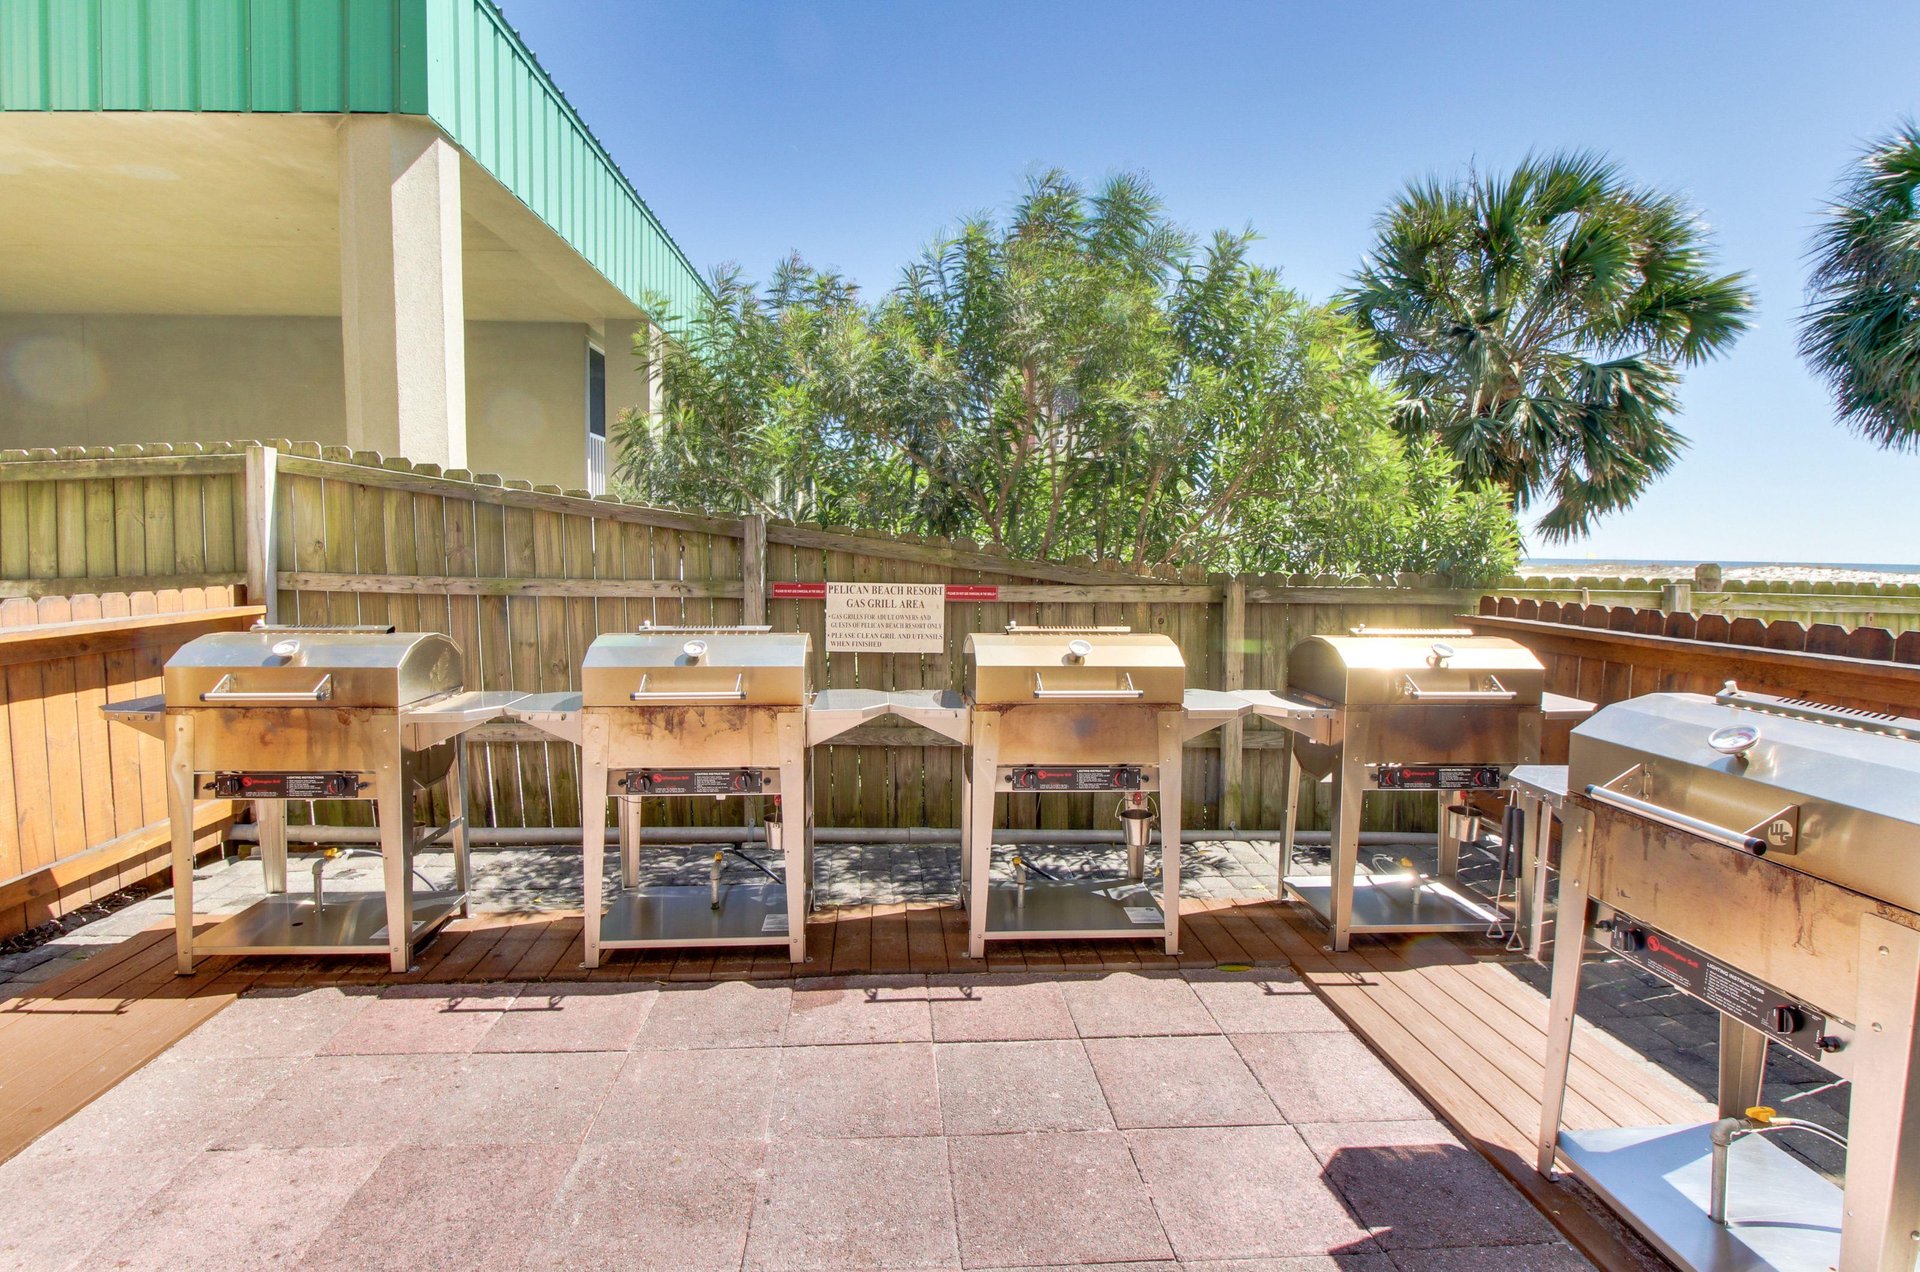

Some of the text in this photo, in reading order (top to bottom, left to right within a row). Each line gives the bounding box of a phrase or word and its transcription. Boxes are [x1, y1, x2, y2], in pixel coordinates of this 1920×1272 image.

[828, 585, 943, 595] PELICAN BEACH RESORT
[847, 599, 925, 608] GAS GRILL AREA
[1707, 962, 1728, 976] LIGHTING
[1729, 973, 1764, 994] INSTRUCTIONS
